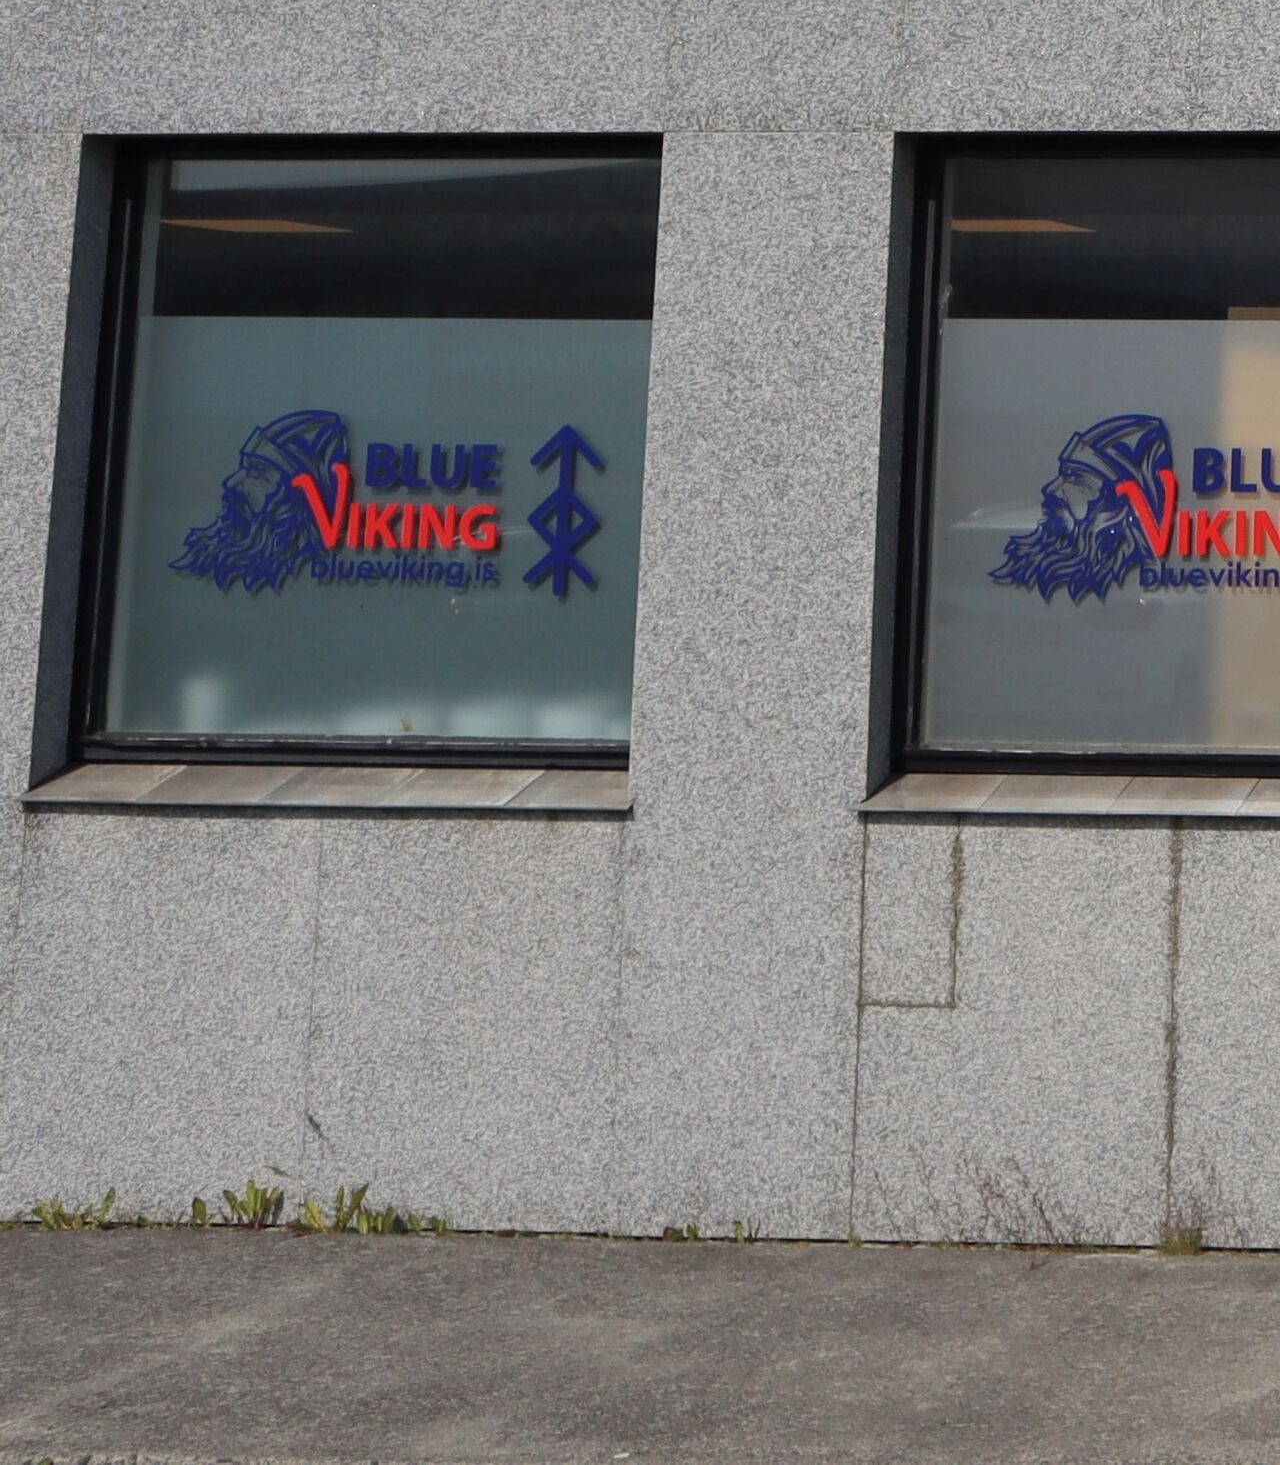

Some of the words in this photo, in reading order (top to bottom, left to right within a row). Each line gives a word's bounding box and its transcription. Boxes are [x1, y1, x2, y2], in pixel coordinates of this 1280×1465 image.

[364, 442, 499, 489] BLUE
[291, 462, 498, 551] VIKING
[309, 552, 496, 588] blueviking.is
